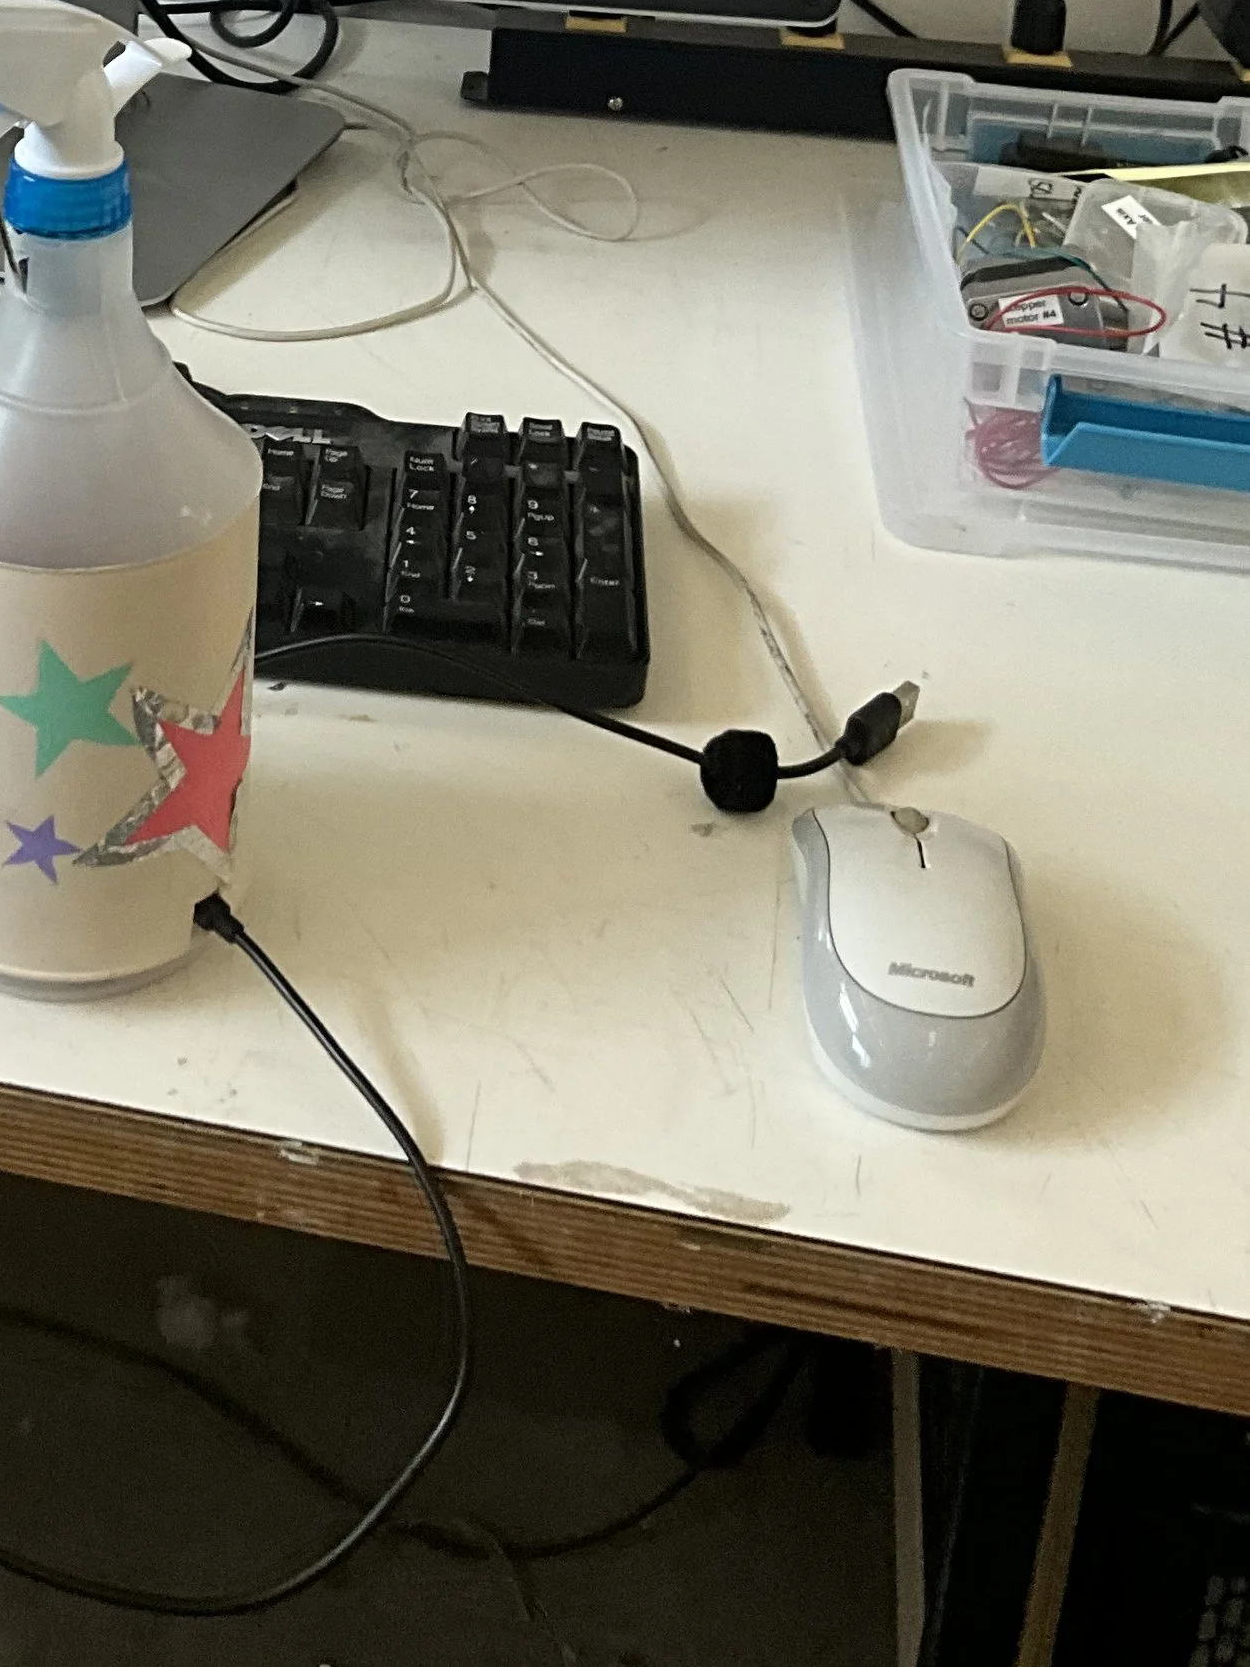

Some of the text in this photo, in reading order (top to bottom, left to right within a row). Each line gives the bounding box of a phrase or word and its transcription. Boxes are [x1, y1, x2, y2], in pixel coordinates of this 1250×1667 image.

[1006, 313, 1040, 325] motor
[267, 447, 295, 457] Home
[324, 448, 349, 457] Page
[408, 463, 436, 473] Lock
[408, 488, 419, 500] 7
[466, 494, 478, 505] 8
[527, 499, 540, 511] 9
[405, 525, 416, 536] 4
[465, 530, 477, 541] 5
[526, 536, 540, 547] 6
[589, 577, 620, 587] Enter
[399, 594, 412, 605] 0
[887, 961, 976, 989] Microsoft
